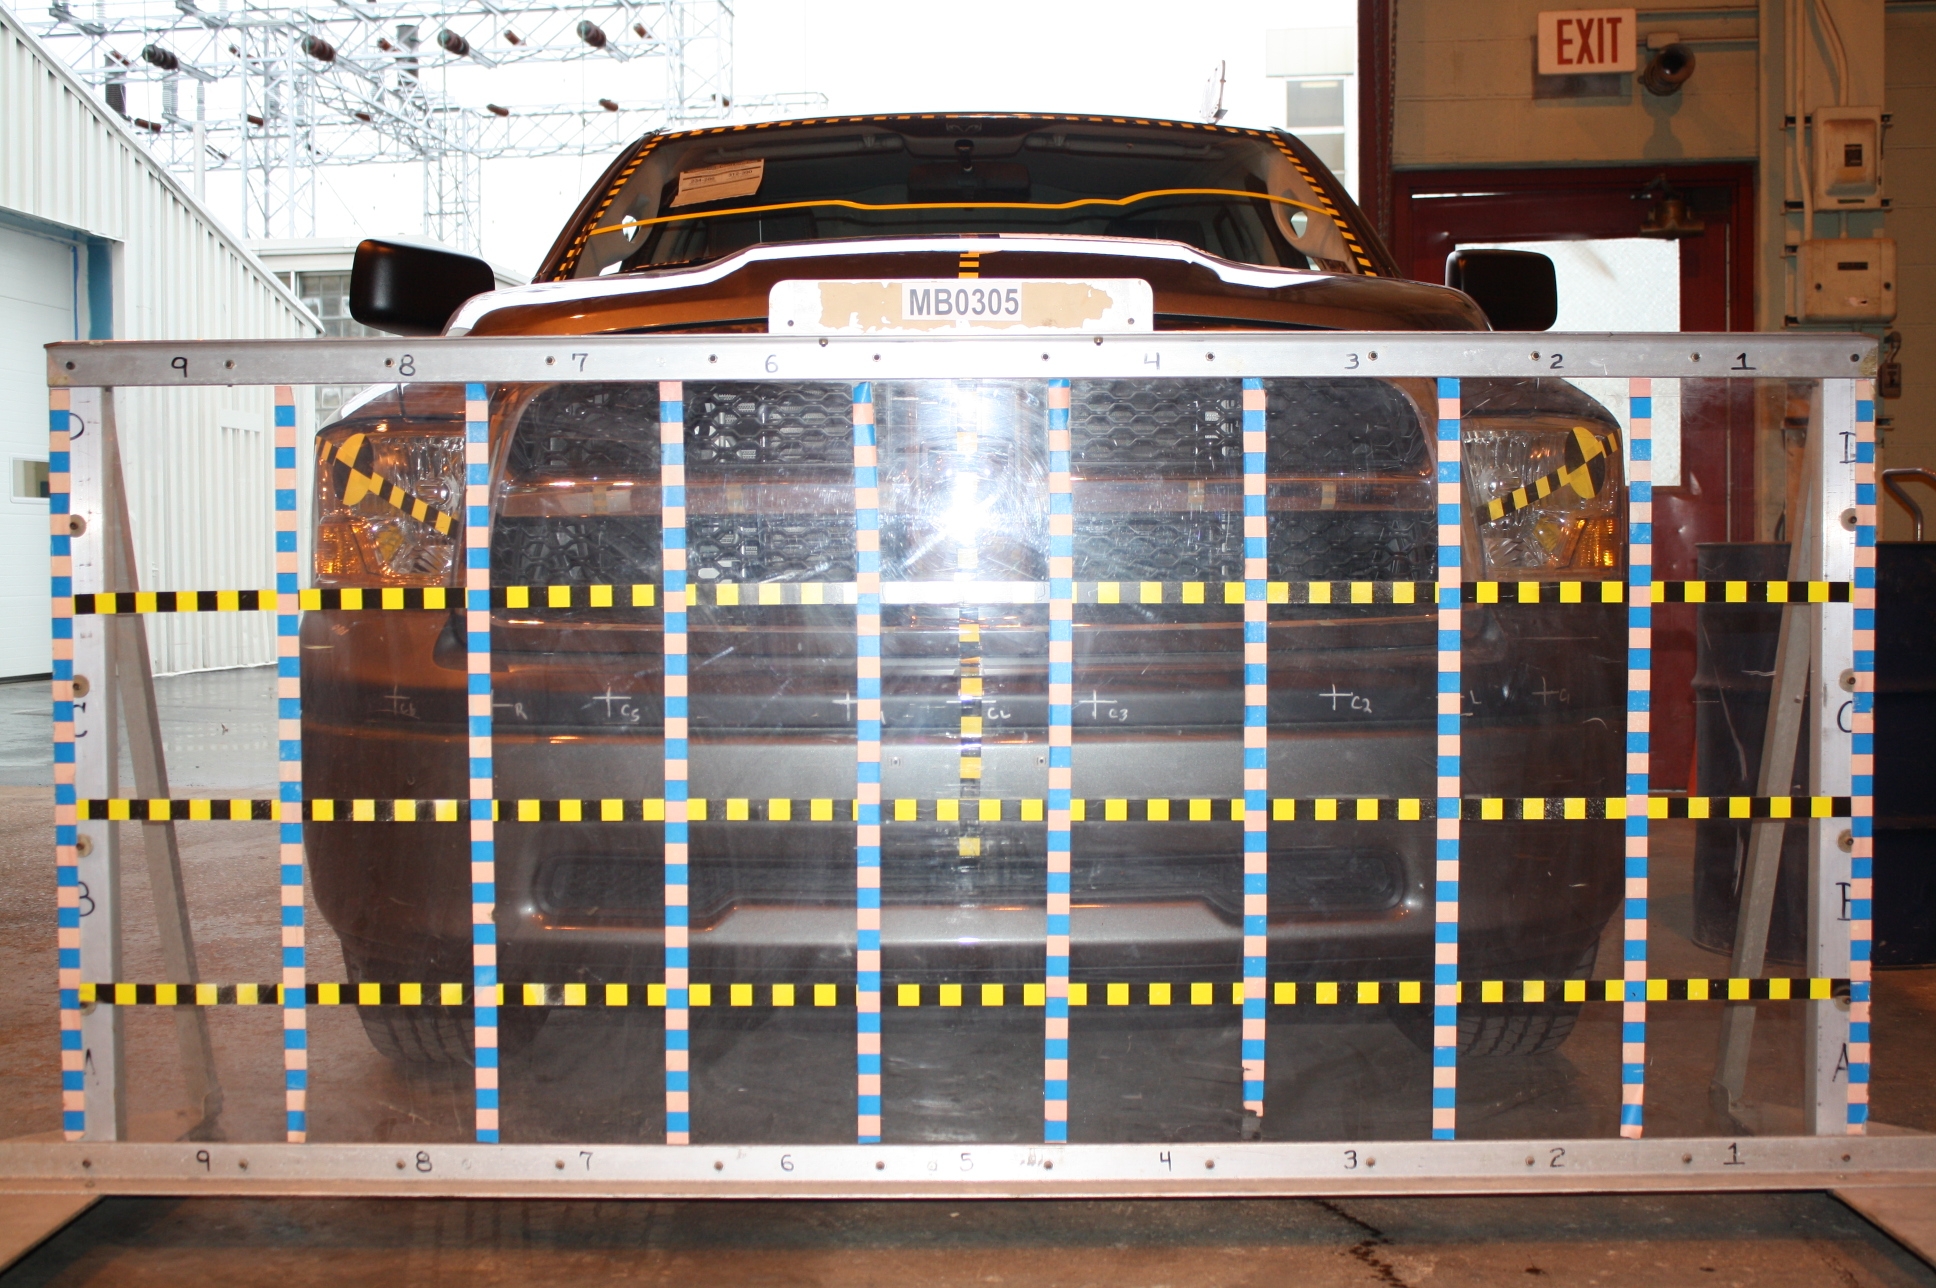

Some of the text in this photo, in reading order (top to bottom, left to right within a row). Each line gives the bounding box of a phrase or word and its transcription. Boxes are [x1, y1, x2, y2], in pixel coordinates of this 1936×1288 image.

[1557, 16, 1623, 66] EXIT
[909, 288, 1019, 316] MB0305
[171, 352, 1757, 378] 9 8 7 6 4 3 2 1
[196, 1150, 211, 1172] 9
[415, 1150, 433, 1173] 8
[579, 1151, 593, 1170] 7
[780, 1153, 795, 1172] 6
[1159, 1151, 1173, 1171] 4
[1343, 1150, 1359, 1169] 3
[1549, 1148, 1566, 1168] 2
[1723, 1142, 1746, 1166] 1
